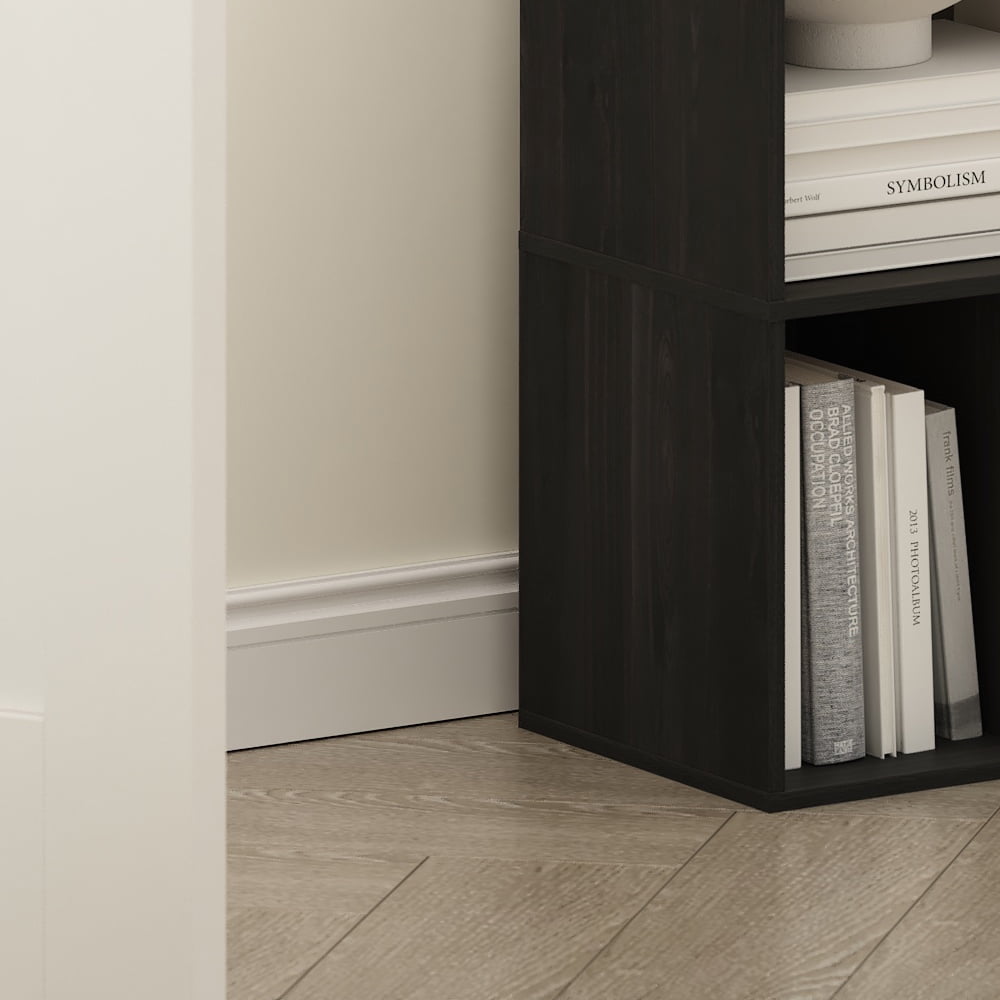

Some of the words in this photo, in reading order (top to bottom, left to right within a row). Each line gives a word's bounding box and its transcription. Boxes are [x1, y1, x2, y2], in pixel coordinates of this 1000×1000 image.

[804, 193, 820, 201] Wolf
[886, 170, 987, 195] SYMBOLISM
[827, 406, 840, 449] BRAD
[842, 404, 853, 457] ALLIED
[942, 431, 953, 463] frank
[809, 409, 826, 509] OCCUPATION
[945, 465, 957, 496] films
[828, 453, 843, 527] CLOEPFIL
[844, 460, 855, 514] WORKS
[908, 509, 918, 535] 2013
[846, 519, 859, 637] ARCHITECTURE
[909, 541, 921, 626] PHOTOALBUM
